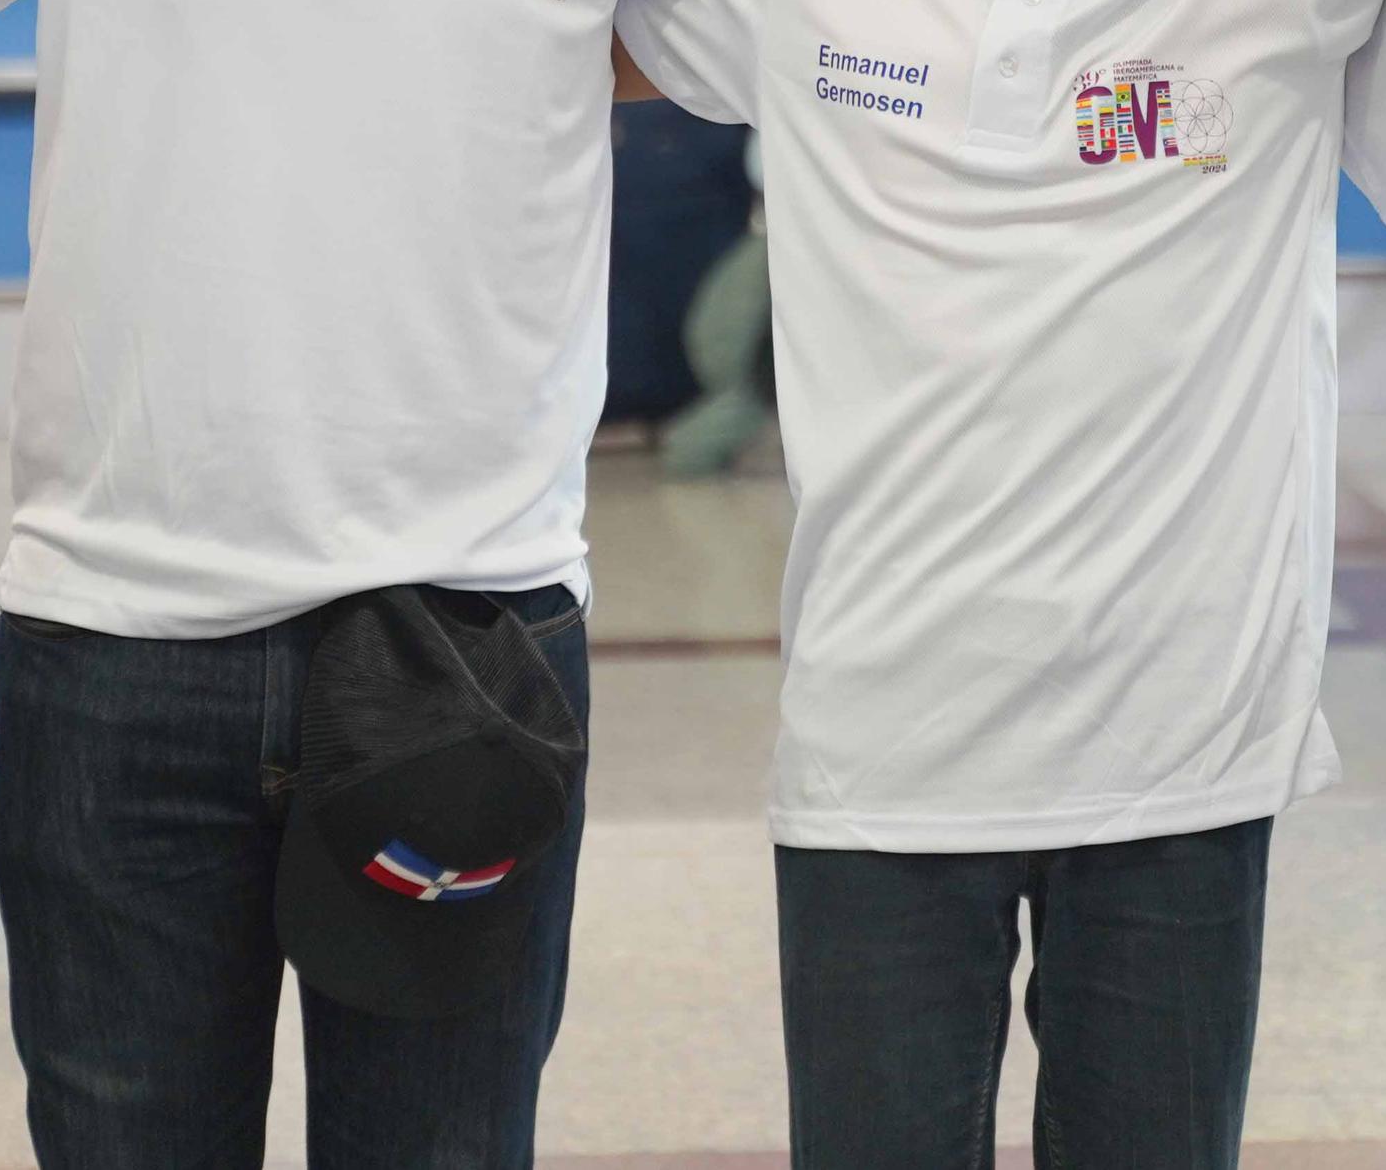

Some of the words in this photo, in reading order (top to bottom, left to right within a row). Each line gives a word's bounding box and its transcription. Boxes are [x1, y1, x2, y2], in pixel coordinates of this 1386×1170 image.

[819, 44, 929, 86] Enmanuel
[816, 77, 923, 118] Germosen
[1202, 164, 1226, 174] 2024
